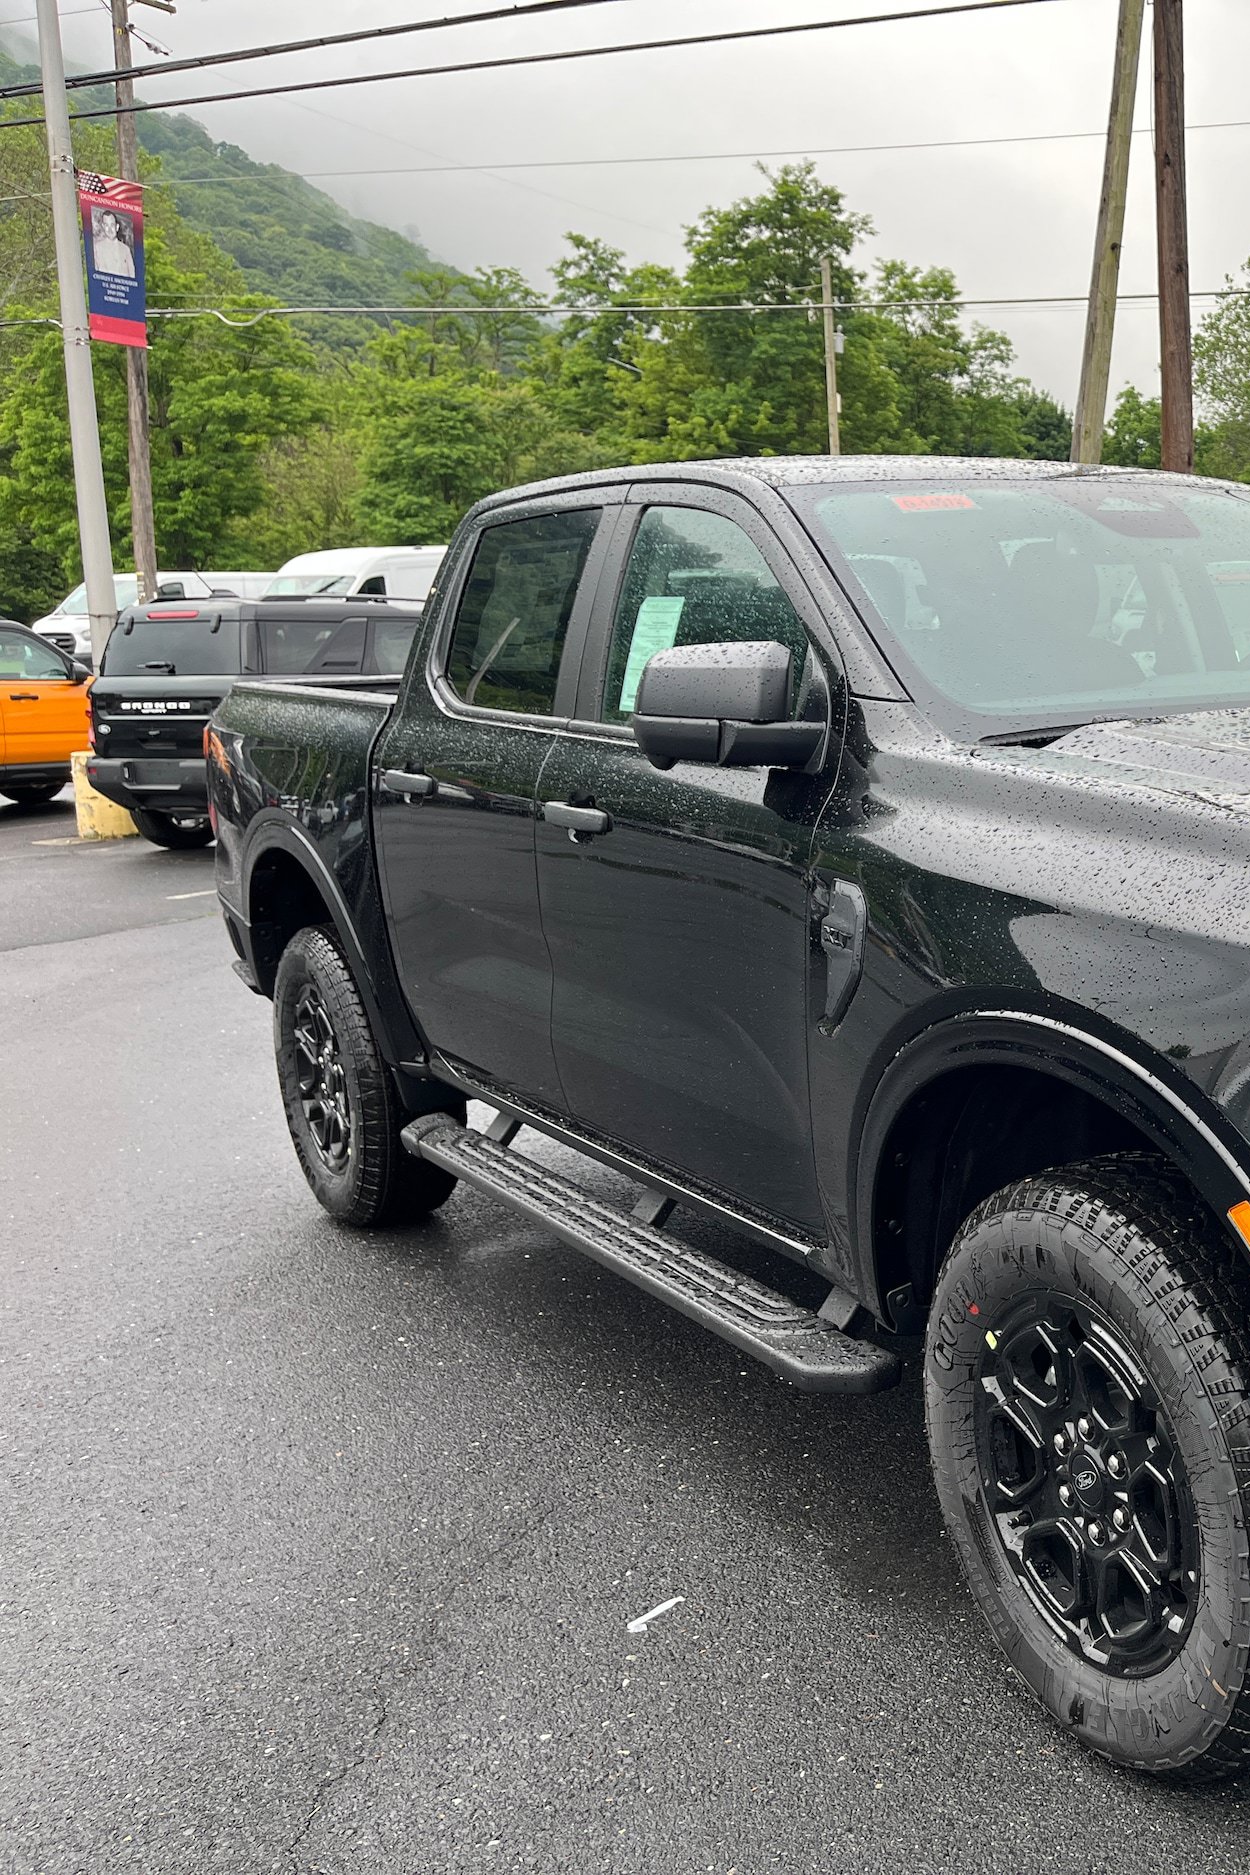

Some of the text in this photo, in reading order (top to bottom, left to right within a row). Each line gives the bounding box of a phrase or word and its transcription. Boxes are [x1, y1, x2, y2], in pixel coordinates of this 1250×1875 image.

[119, 202, 143, 214] HONORS
[121, 702, 191, 710] BRONCO
[823, 925, 852, 949] XLT
[1078, 1473, 1093, 1488] Ford
